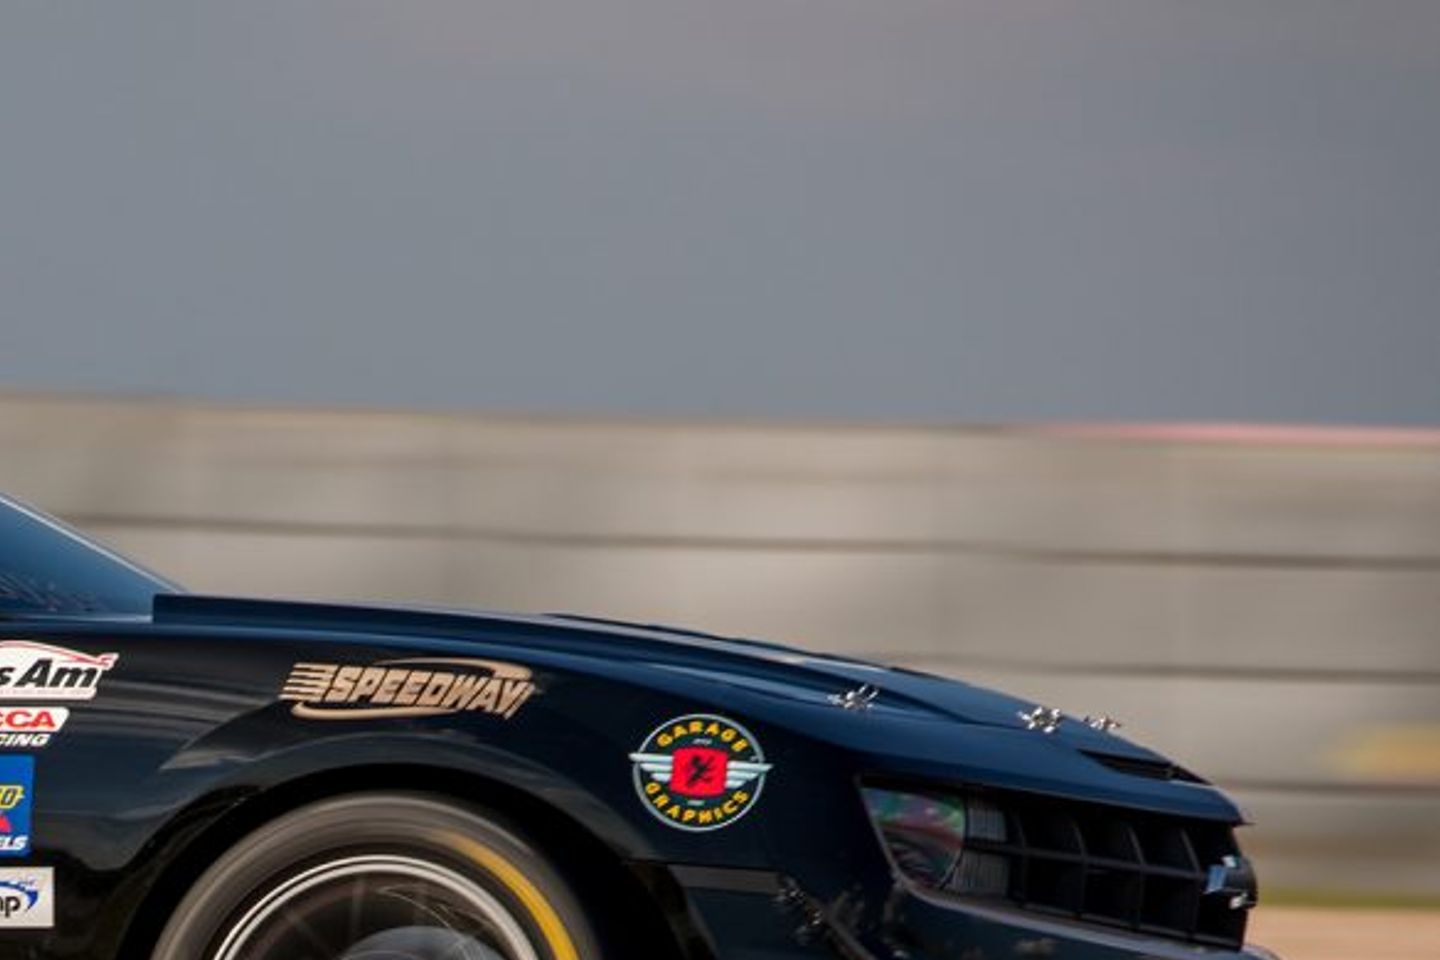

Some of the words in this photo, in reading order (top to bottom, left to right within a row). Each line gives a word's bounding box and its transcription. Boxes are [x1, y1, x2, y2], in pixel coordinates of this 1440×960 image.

[15, 658, 102, 688] Am
[322, 664, 536, 720] SPEEDWAY
[656, 720, 749, 753] GARAGE
[644, 781, 750, 824] GRAPHICS
